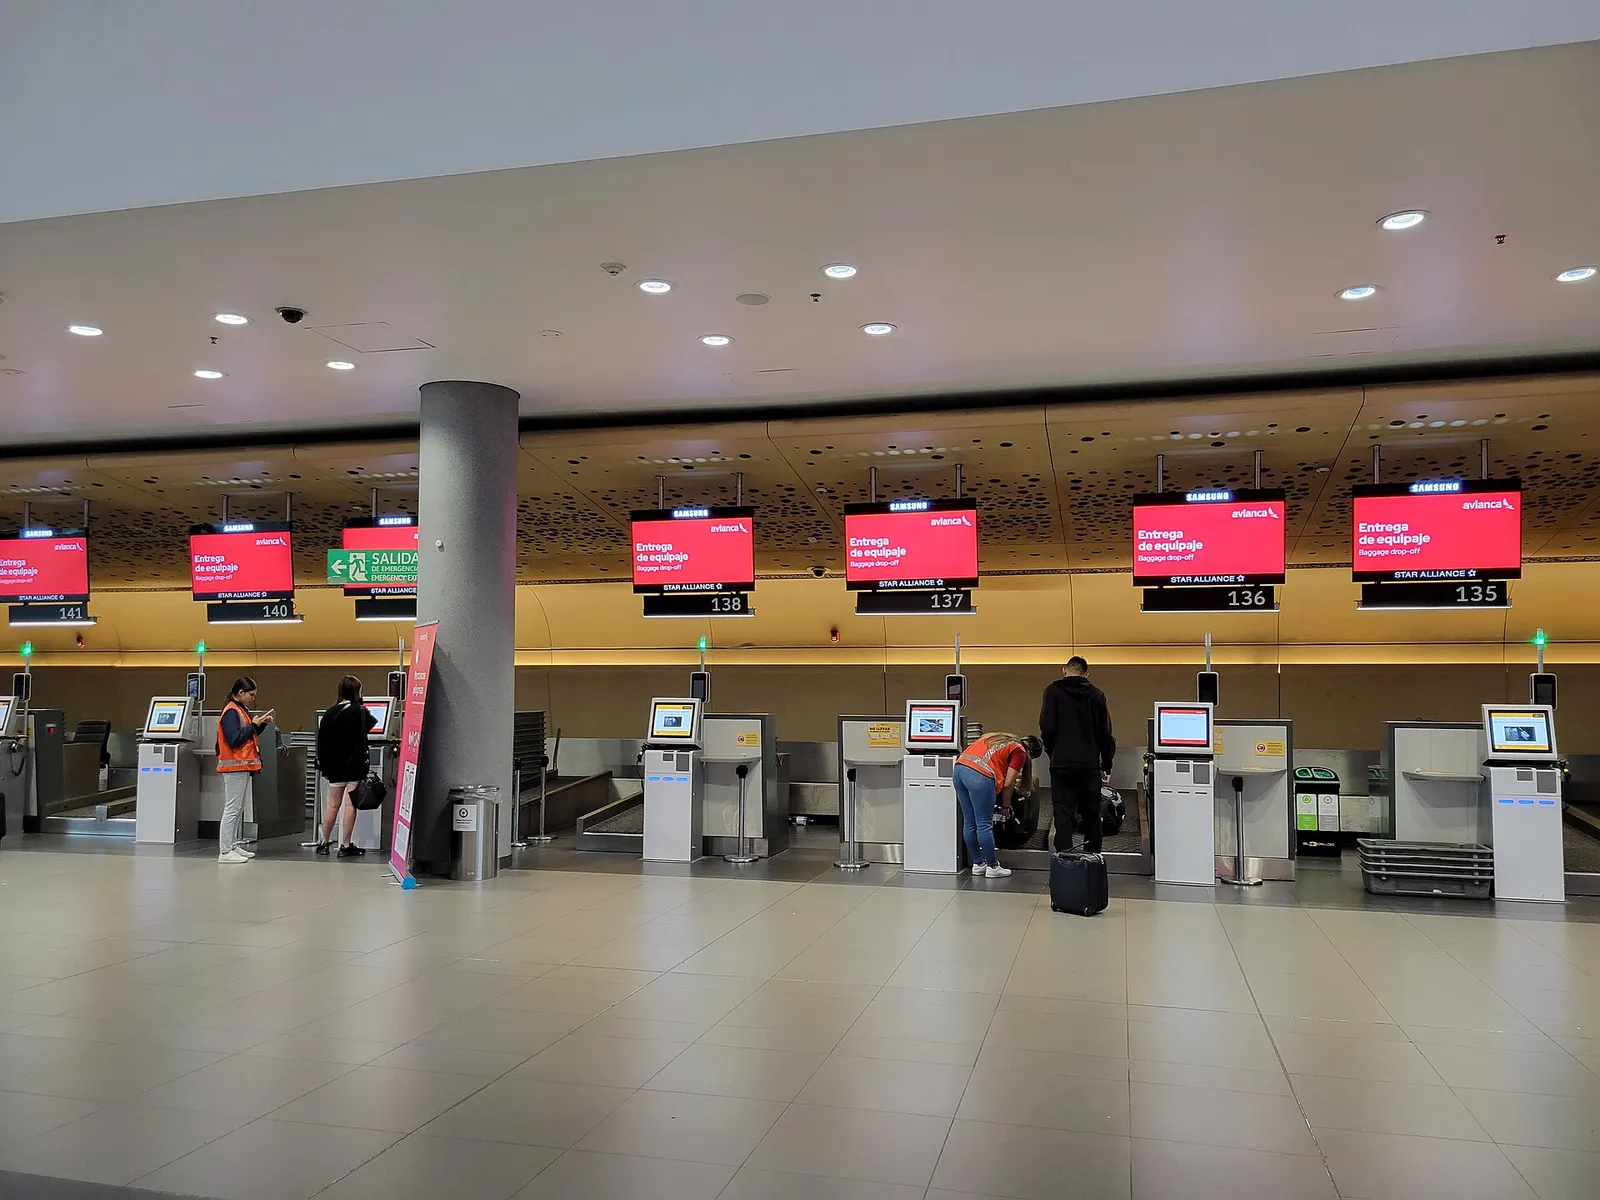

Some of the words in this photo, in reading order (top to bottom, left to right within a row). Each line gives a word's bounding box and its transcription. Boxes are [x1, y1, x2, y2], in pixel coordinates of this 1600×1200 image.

[1411, 483, 1459, 492] SAMSUNG
[1186, 493, 1229, 501] SAMSUNG
[890, 502, 928, 510] SAMSUNG
[1463, 500, 1502, 509] avianca
[674, 509, 709, 517] SAMSUNG
[1232, 509, 1267, 518] avianca
[379, 517, 411, 526] SAMSUNG
[931, 517, 961, 526] avianca
[711, 524, 739, 532] avianca
[1359, 523, 1409, 533] Entrega
[1138, 530, 1183, 540] Entrega
[1359, 535, 1375, 544] de
[1377, 533, 1430, 545] equipaje
[636, 543, 673, 552] Entrega
[849, 538, 889, 547] Entrega
[1138, 542, 1153, 551] de
[1154, 540, 1203, 552] equipaje
[637, 554, 648, 562] de
[649, 552, 689, 562] equipaje
[850, 549, 863, 557] de
[864, 547, 907, 558] equipaje
[194, 555, 225, 564] Entrega
[372, 552, 419, 564] SALIDA
[8, 567, 38, 577] equipaje
[195, 564, 205, 572] de
[206, 563, 238, 572] equipaje
[1228, 591, 1266, 606] 136
[1456, 586, 1497, 602] 135
[711, 597, 741, 611] 138
[931, 594, 963, 608] 137
[60, 607, 82, 619] 141
[262, 604, 288, 618] 140
